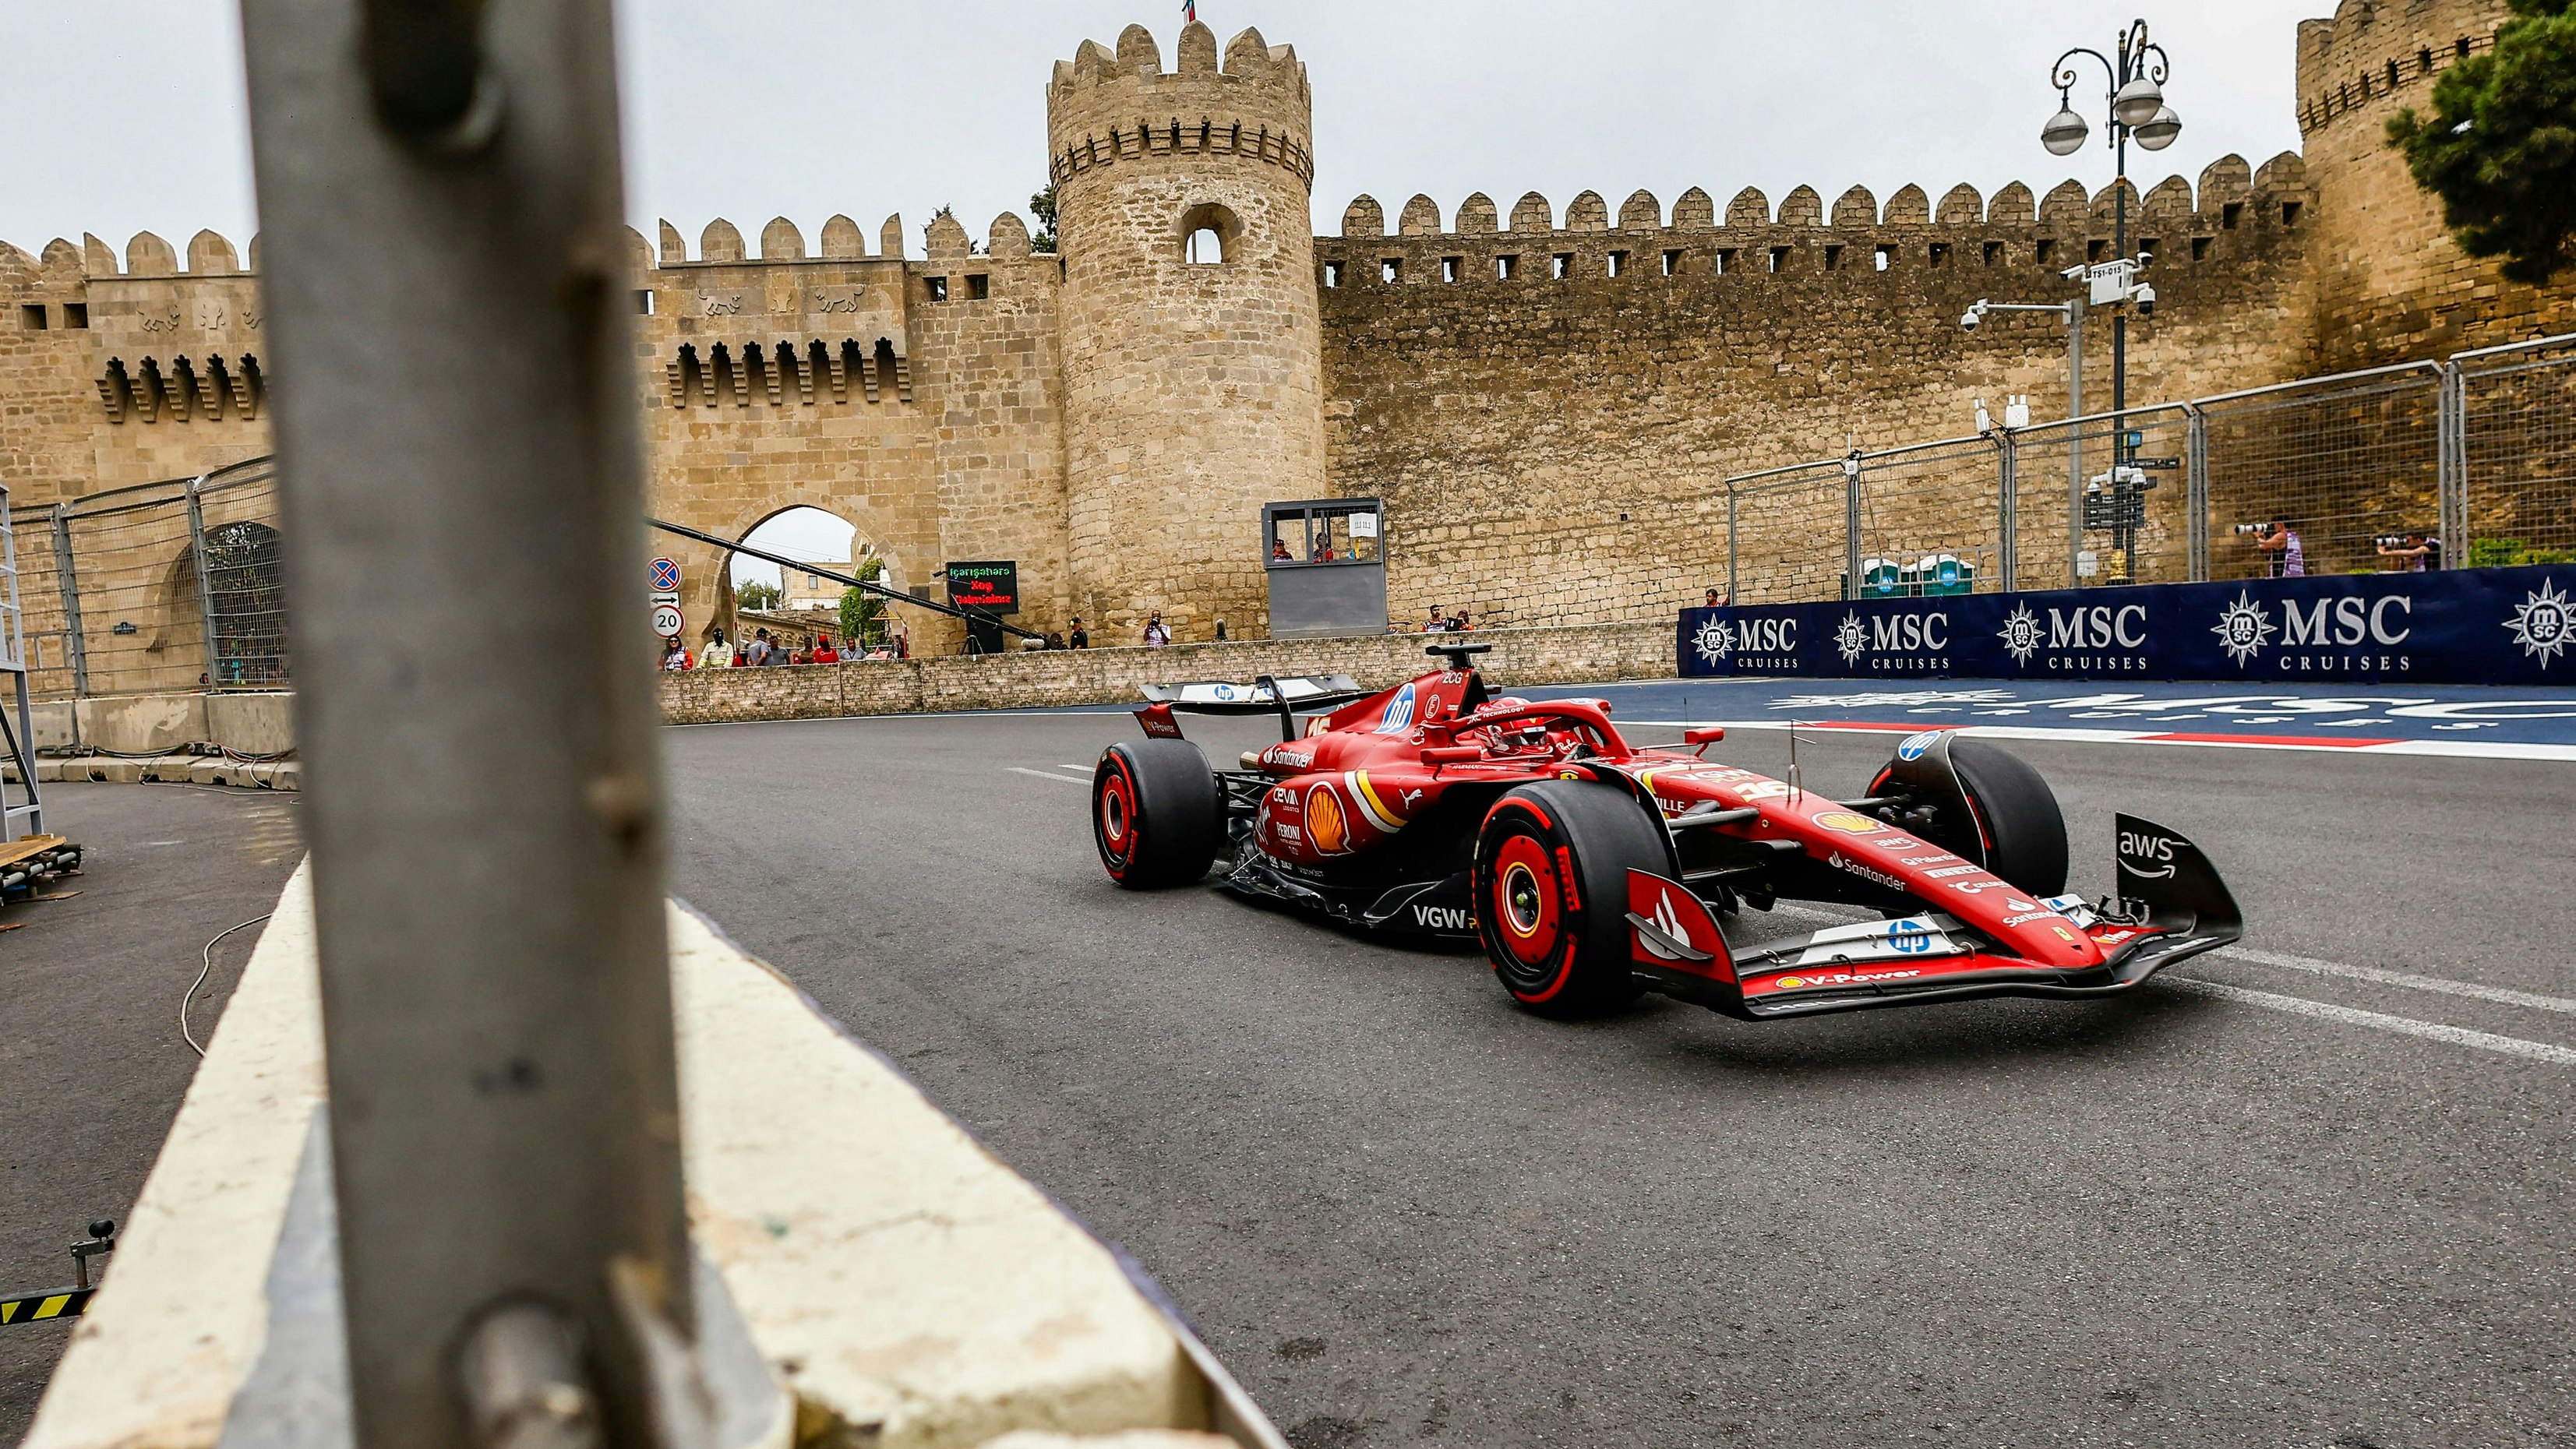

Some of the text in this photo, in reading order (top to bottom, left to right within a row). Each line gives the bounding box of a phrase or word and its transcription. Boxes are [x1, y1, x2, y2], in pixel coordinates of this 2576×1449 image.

[658, 615, 677, 628] 20
[2048, 605, 2147, 648] MSC
[2281, 595, 2411, 646] MSC
[1738, 618, 1797, 651] MSC
[1872, 612, 1947, 651] MSC
[1738, 658, 1798, 668] CRUISES
[1872, 658, 1949, 669] CRUISES
[2049, 657, 2147, 670] CRUISES
[2280, 656, 2409, 670] CRUISES
[1218, 685, 1232, 700] hp
[1382, 683, 1414, 733] hp
[1483, 707, 1525, 718] TECHNOLOGY
[1149, 721, 1175, 733] V-Power
[1900, 732, 1940, 760] hp
[1272, 748, 1312, 768] Santander
[1731, 780, 1801, 803] 16
[1276, 821, 1300, 840] PERONI
[1872, 837, 1912, 847] aws
[2119, 831, 2174, 861] aws
[1844, 858, 1906, 891] Santander
[1413, 904, 1466, 929] VGW
[1895, 920, 1925, 953] hp
[1806, 968, 1920, 985] V-Power
